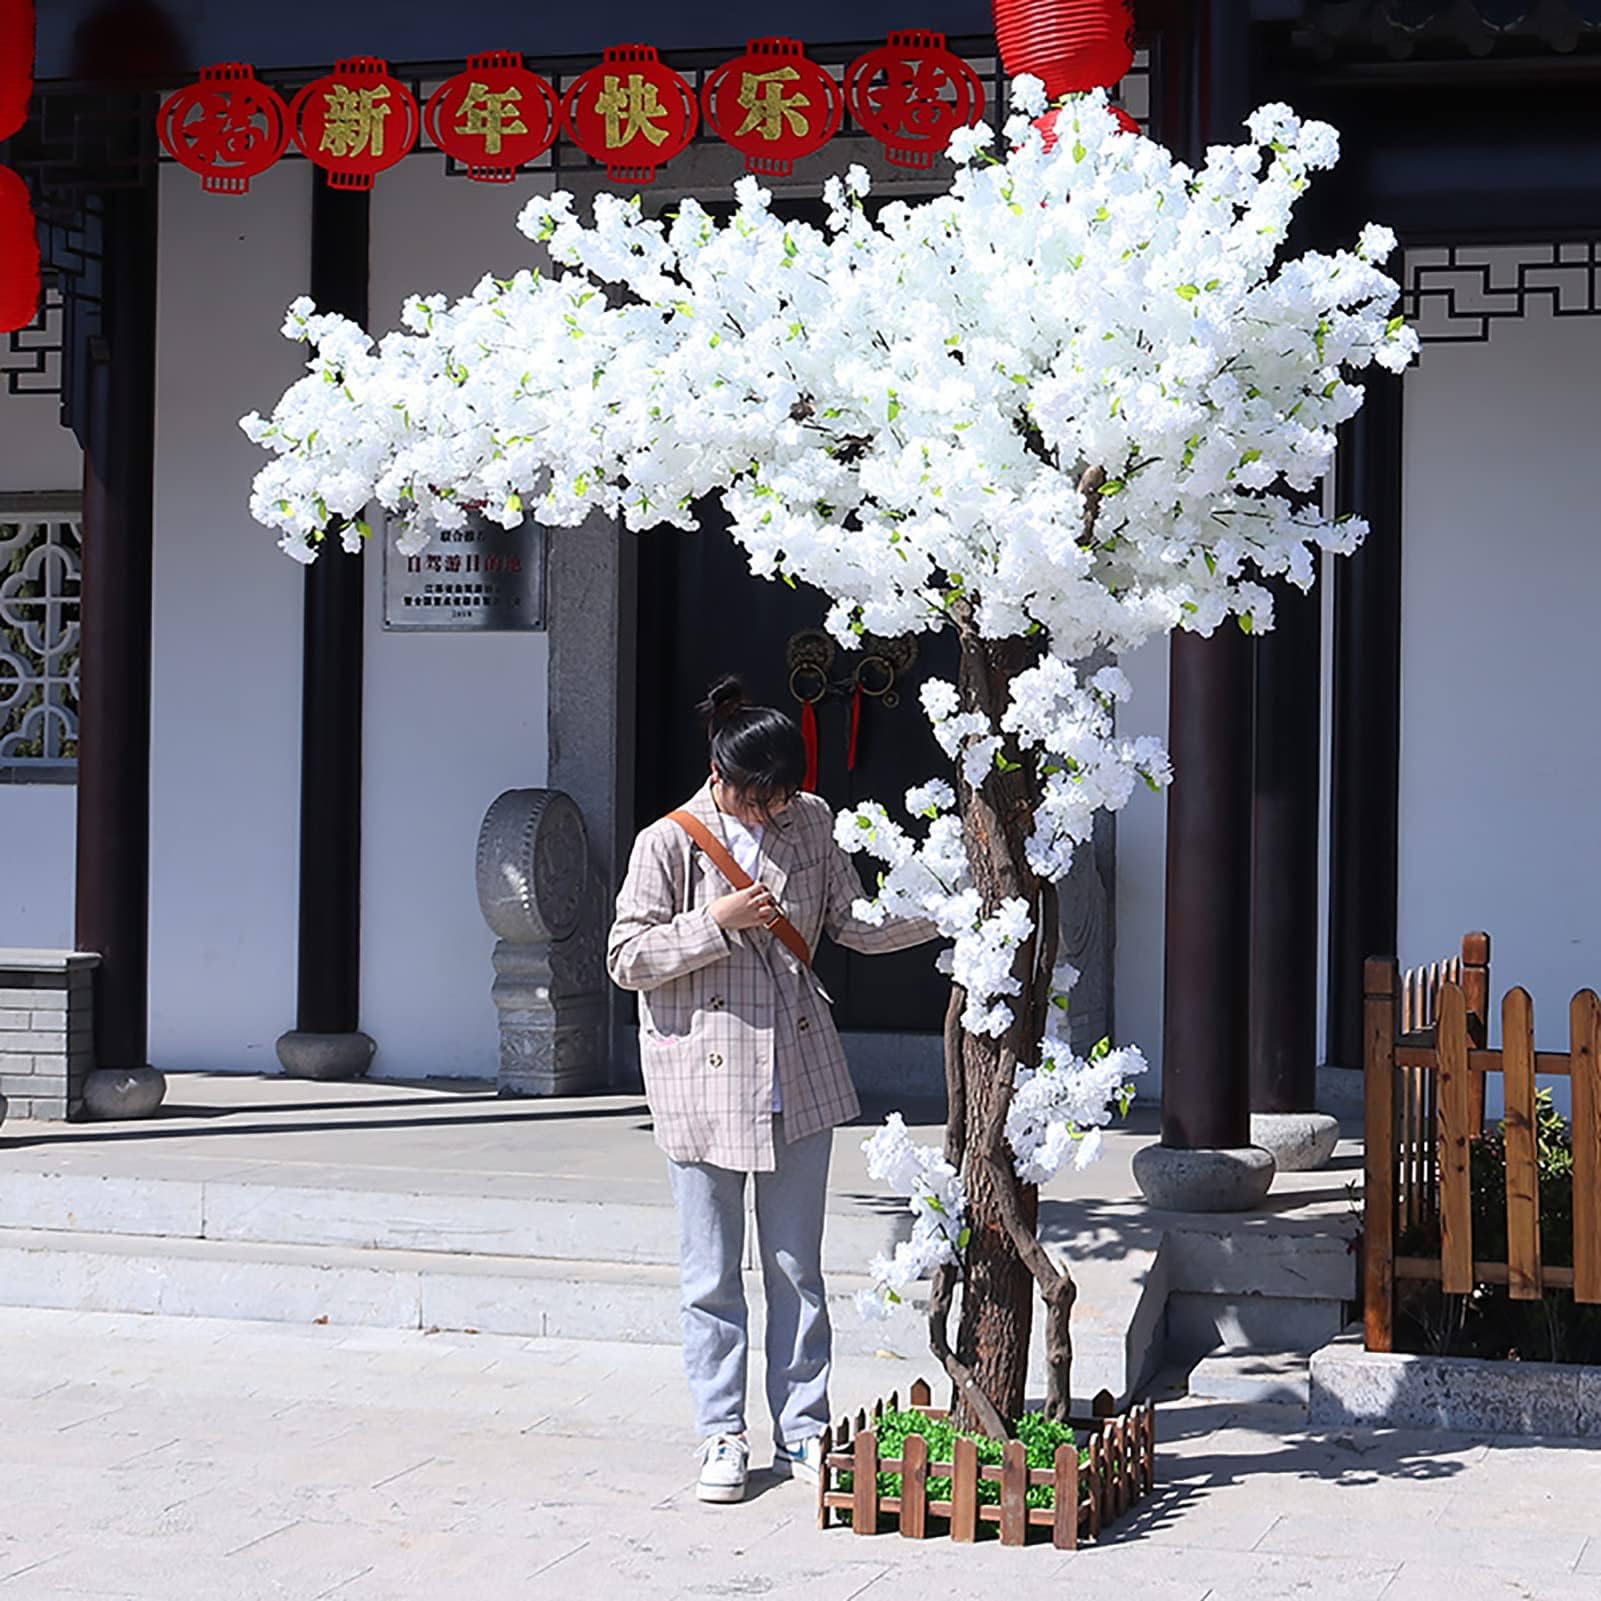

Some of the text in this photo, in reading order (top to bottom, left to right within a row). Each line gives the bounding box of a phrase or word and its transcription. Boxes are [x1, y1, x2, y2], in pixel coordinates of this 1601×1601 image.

[318, 66, 811, 158] 新年快乐
[407, 554, 522, 573] 自驾游目的地
